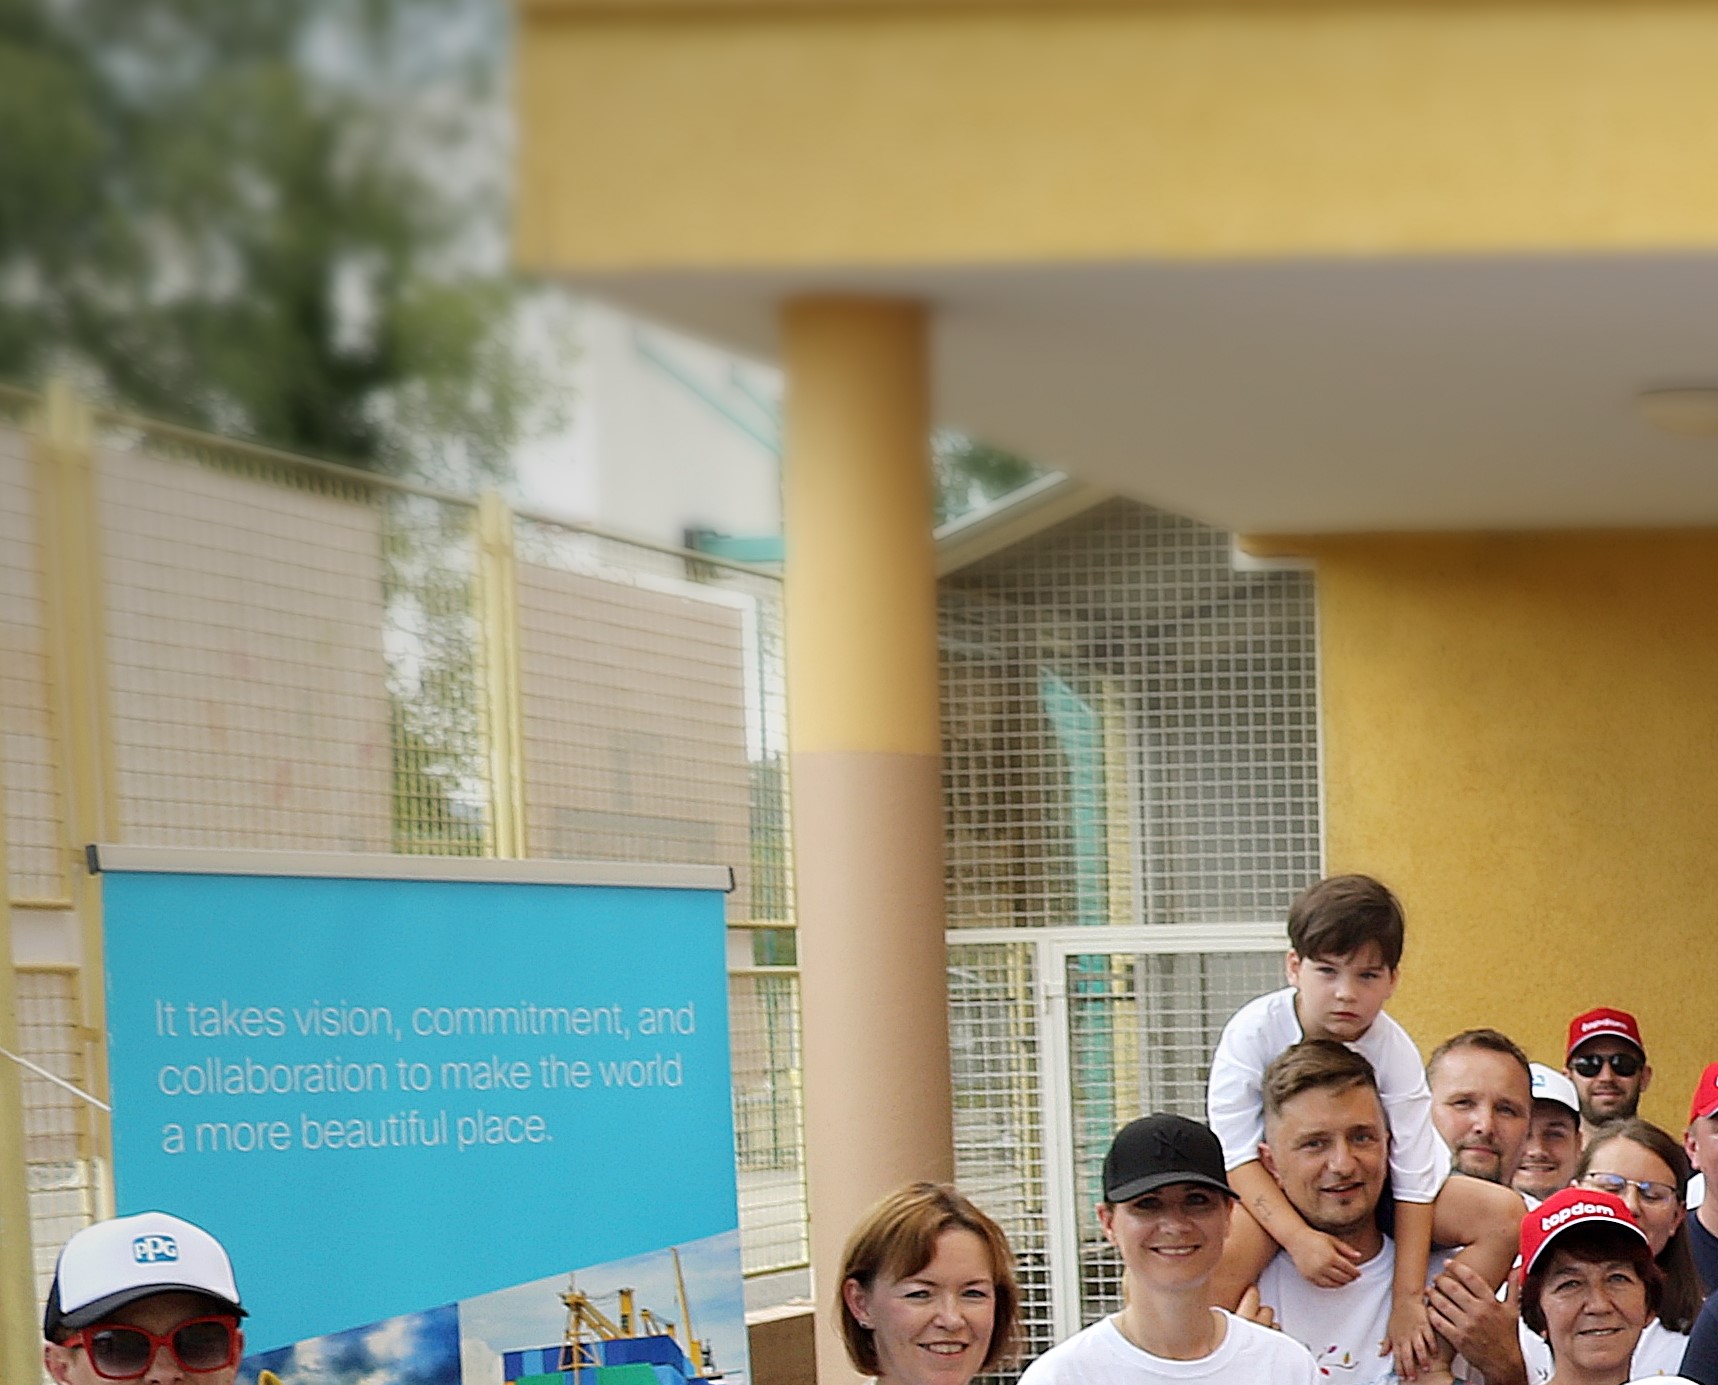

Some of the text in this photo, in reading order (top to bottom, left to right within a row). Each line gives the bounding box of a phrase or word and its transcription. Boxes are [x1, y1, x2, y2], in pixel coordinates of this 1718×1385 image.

[156, 999, 696, 1043] It takes vision, commitment, and
[160, 1052, 683, 1096] collaboration to make the world
[163, 1111, 553, 1155] a more beautiful place.
[1542, 1201, 1614, 1233] topdom
[134, 1235, 179, 1262] PPG
